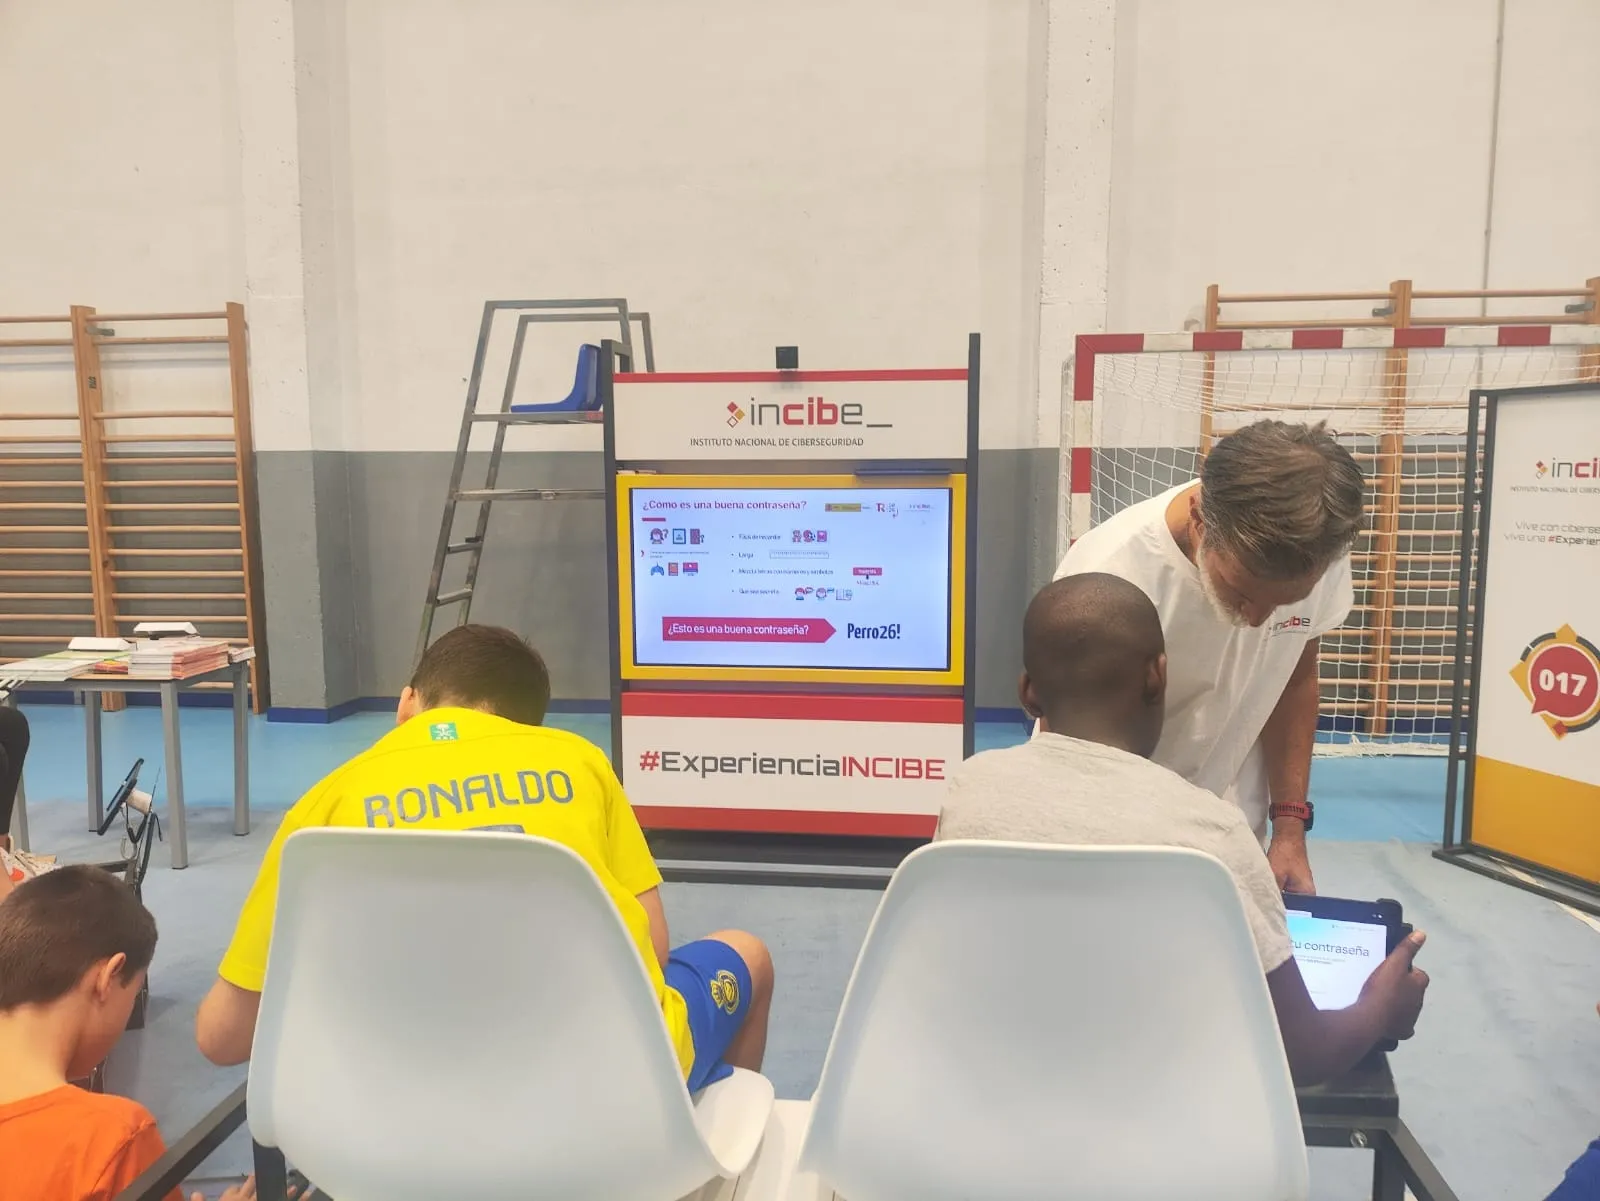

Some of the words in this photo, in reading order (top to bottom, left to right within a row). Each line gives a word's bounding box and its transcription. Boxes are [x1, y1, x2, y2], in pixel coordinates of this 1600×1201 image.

[690, 437, 733, 447] INSTITUTO
[734, 437, 776, 447] NACIONAL
[778, 438, 790, 447] DE
[792, 437, 864, 447] CIBERSEGURIDAD
[1551, 457, 1600, 478] inci
[679, 502, 691, 510] es
[693, 502, 712, 510] una
[714, 500, 744, 510] buena
[667, 623, 692, 635] ¿Esto
[693, 625, 705, 634] es
[706, 625, 723, 634] una
[724, 624, 752, 634] buena
[753, 624, 809, 635] contraseña?
[847, 623, 901, 640] Perro26!
[1539, 668, 1588, 697] 017
[639, 750, 946, 780] #ExperienciaINCIBE
[363, 770, 574, 829] RONALDO
[1304, 942, 1370, 957] contraseña
